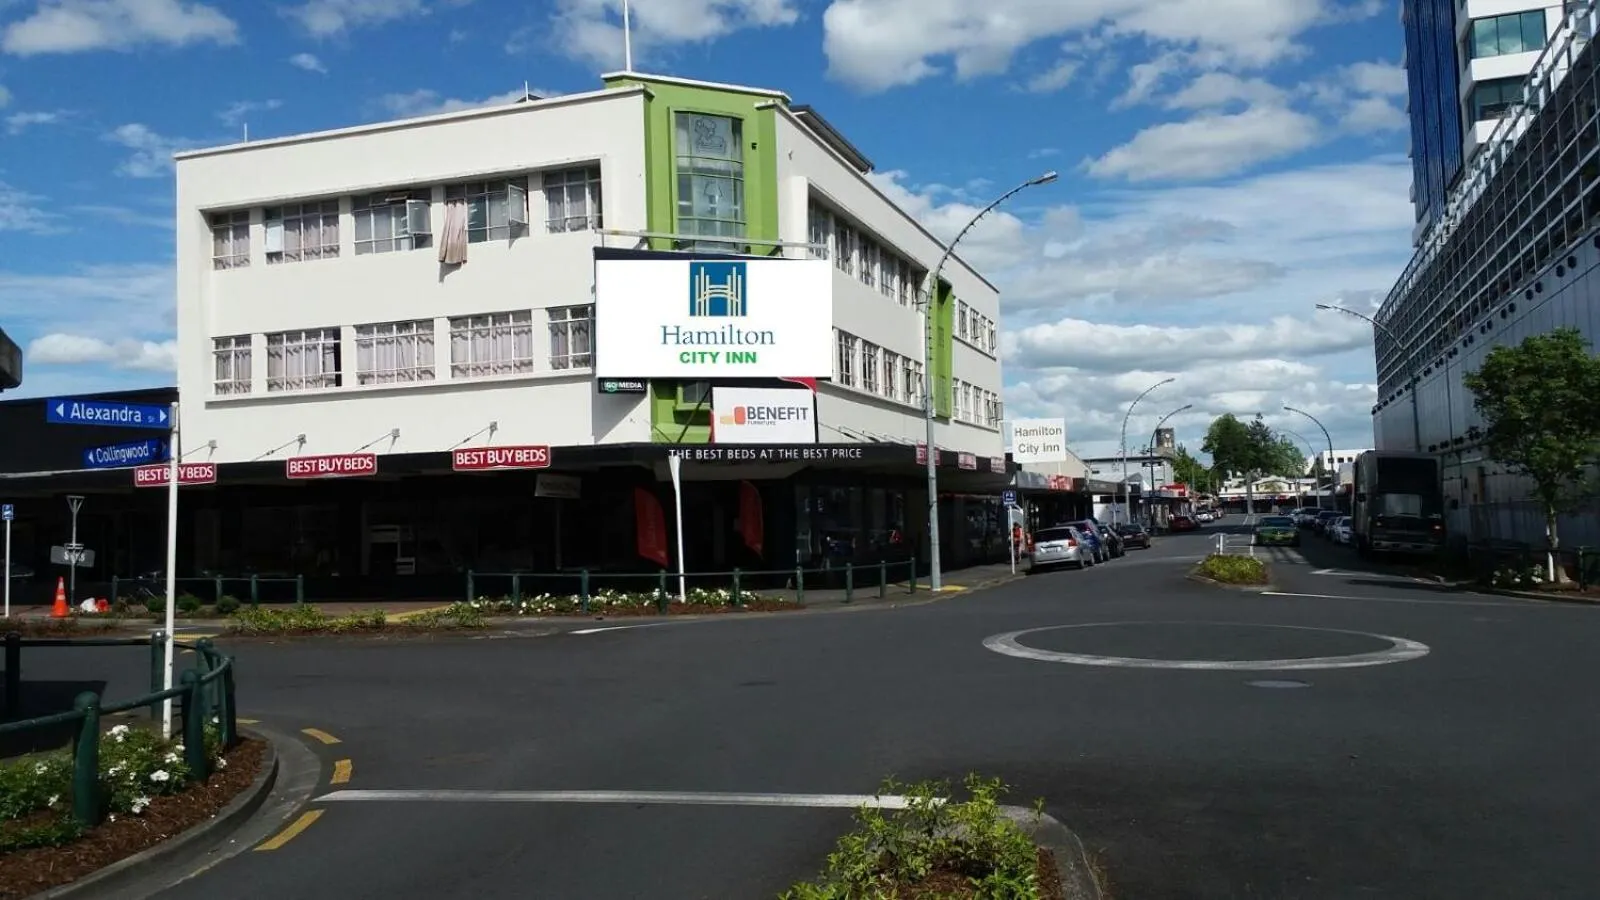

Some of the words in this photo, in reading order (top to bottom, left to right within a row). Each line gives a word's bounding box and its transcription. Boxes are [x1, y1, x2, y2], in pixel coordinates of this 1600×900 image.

[661, 324, 776, 345] Hamilton
[679, 351, 720, 364] CITY
[726, 351, 757, 364] INN
[70, 402, 142, 423] Alexandra
[747, 406, 809, 421] BENEFIT
[1014, 426, 1062, 437] Hamilton
[96, 440, 149, 463] Collingwood
[455, 451, 486, 465] BEST
[486, 449, 515, 464] BUY
[514, 448, 547, 463] BEDS
[669, 449, 692, 459] THE
[695, 449, 724, 459] BEST
[727, 449, 756, 459] BEDS
[759, 449, 775, 459] AT
[777, 449, 799, 459] THE
[803, 448, 830, 459] BEST
[832, 448, 862, 459] PRICE
[1018, 443, 1039, 455] City
[1043, 443, 1060, 452] Inn
[289, 460, 317, 473] BEST
[318, 457, 343, 472] BUY
[343, 456, 373, 471] BEDS
[137, 468, 162, 481] BEST
[163, 466, 186, 480] BY
[186, 465, 213, 479] BEDS
